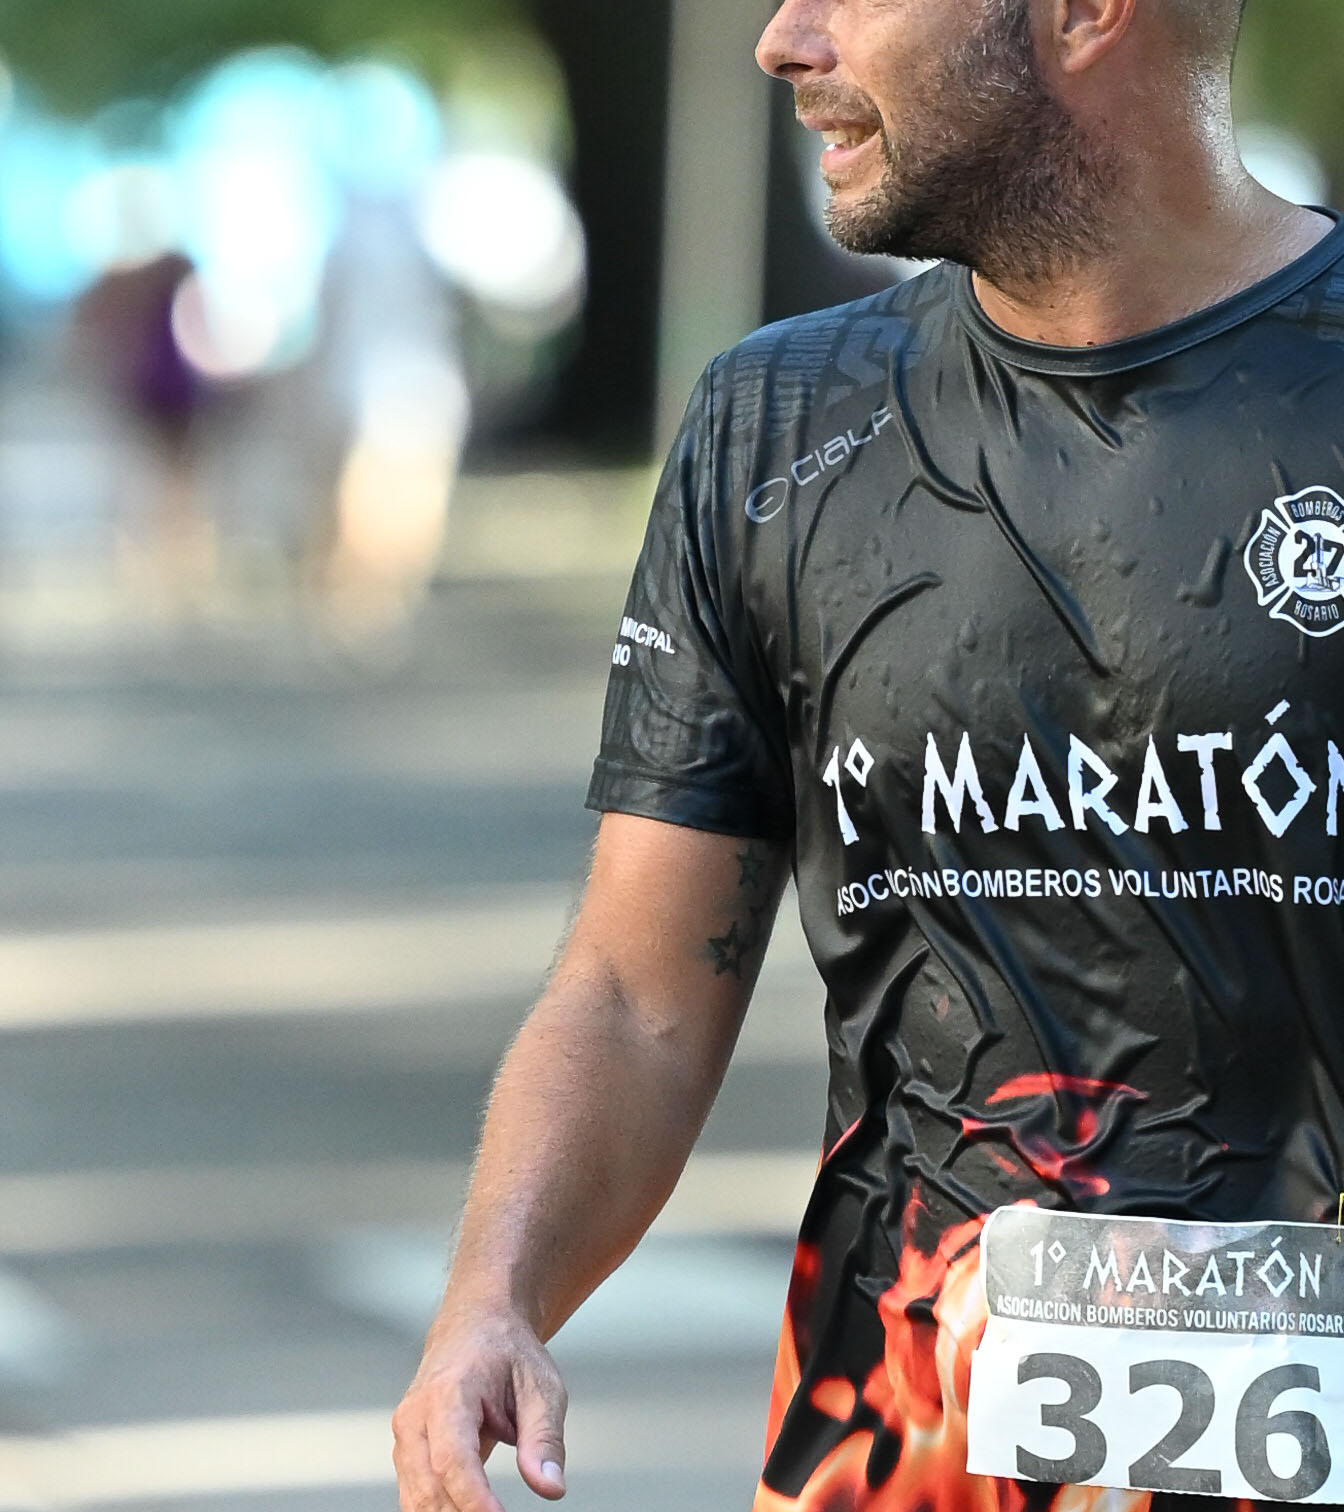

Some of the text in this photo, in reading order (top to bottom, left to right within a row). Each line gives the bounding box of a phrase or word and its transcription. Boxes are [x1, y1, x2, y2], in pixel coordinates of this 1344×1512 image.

[1293, 599, 1340, 621] ROSARIO
[942, 868, 1102, 899] BOMBEROS
[1108, 867, 1284, 903] VOLUNTARIOS
[1082, 1235, 1323, 1300] MARATÓN
[1087, 1304, 1178, 1328] BOMBEROS
[1183, 1308, 1296, 1332] VOLUNTARIOS
[1015, 1352, 1332, 1501] 326
